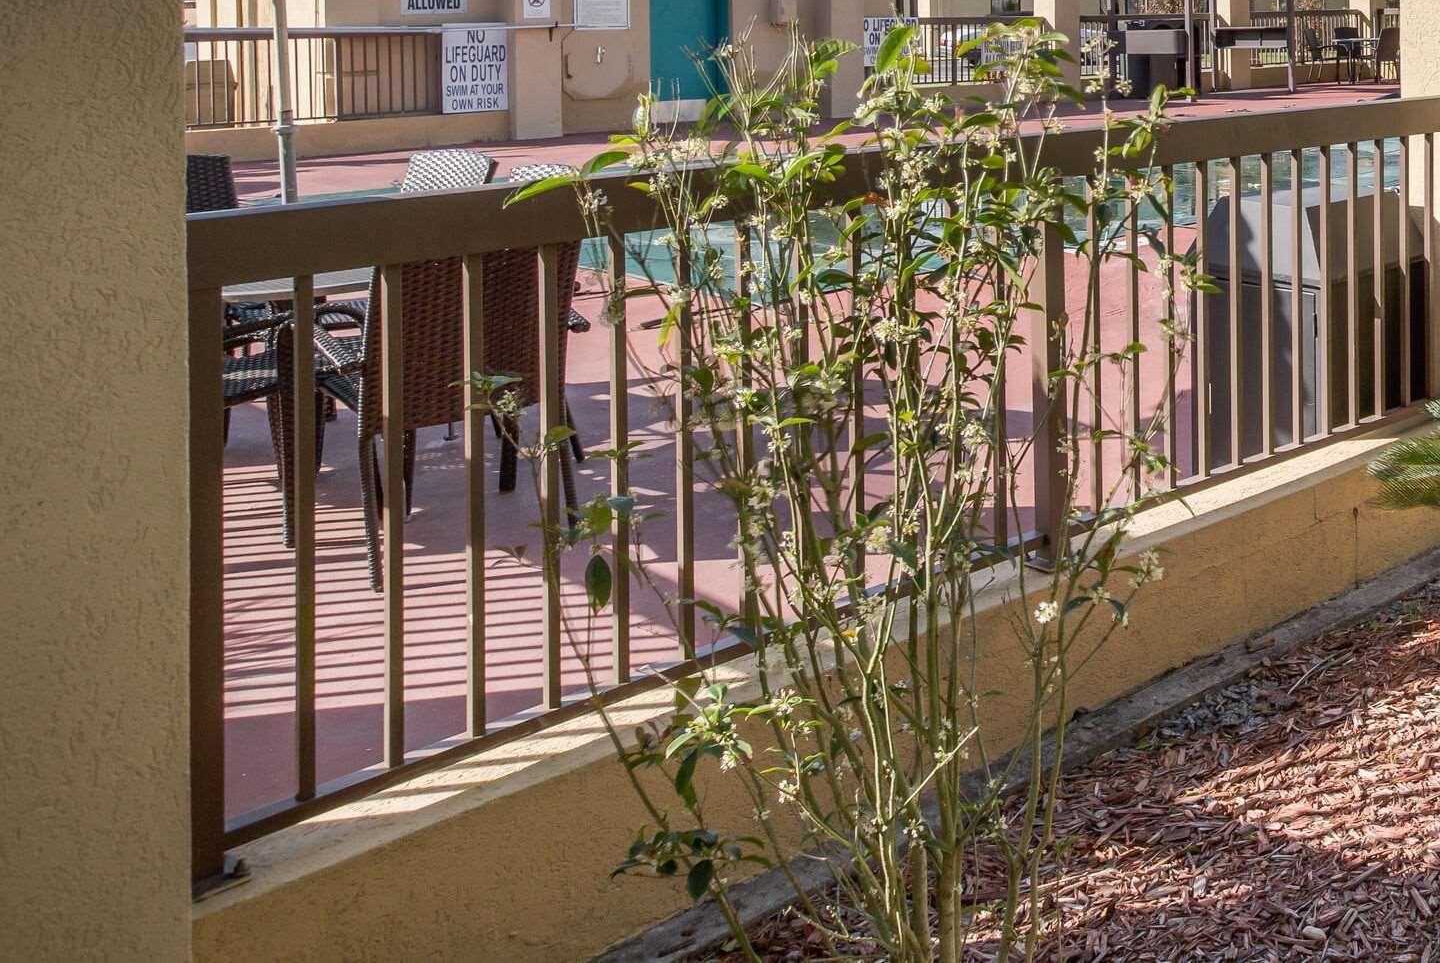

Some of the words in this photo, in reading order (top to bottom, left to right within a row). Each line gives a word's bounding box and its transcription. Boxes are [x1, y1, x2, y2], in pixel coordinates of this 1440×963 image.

[467, 29, 486, 44] NO
[445, 45, 506, 63] LIFEGUARD
[450, 65, 467, 83] ON
[471, 64, 501, 82] DUTY
[446, 85, 468, 97] SWIM
[470, 85, 479, 95] AT
[481, 83, 504, 95] YOUR
[452, 99, 474, 111] OWN
[477, 97, 500, 109] RISK
